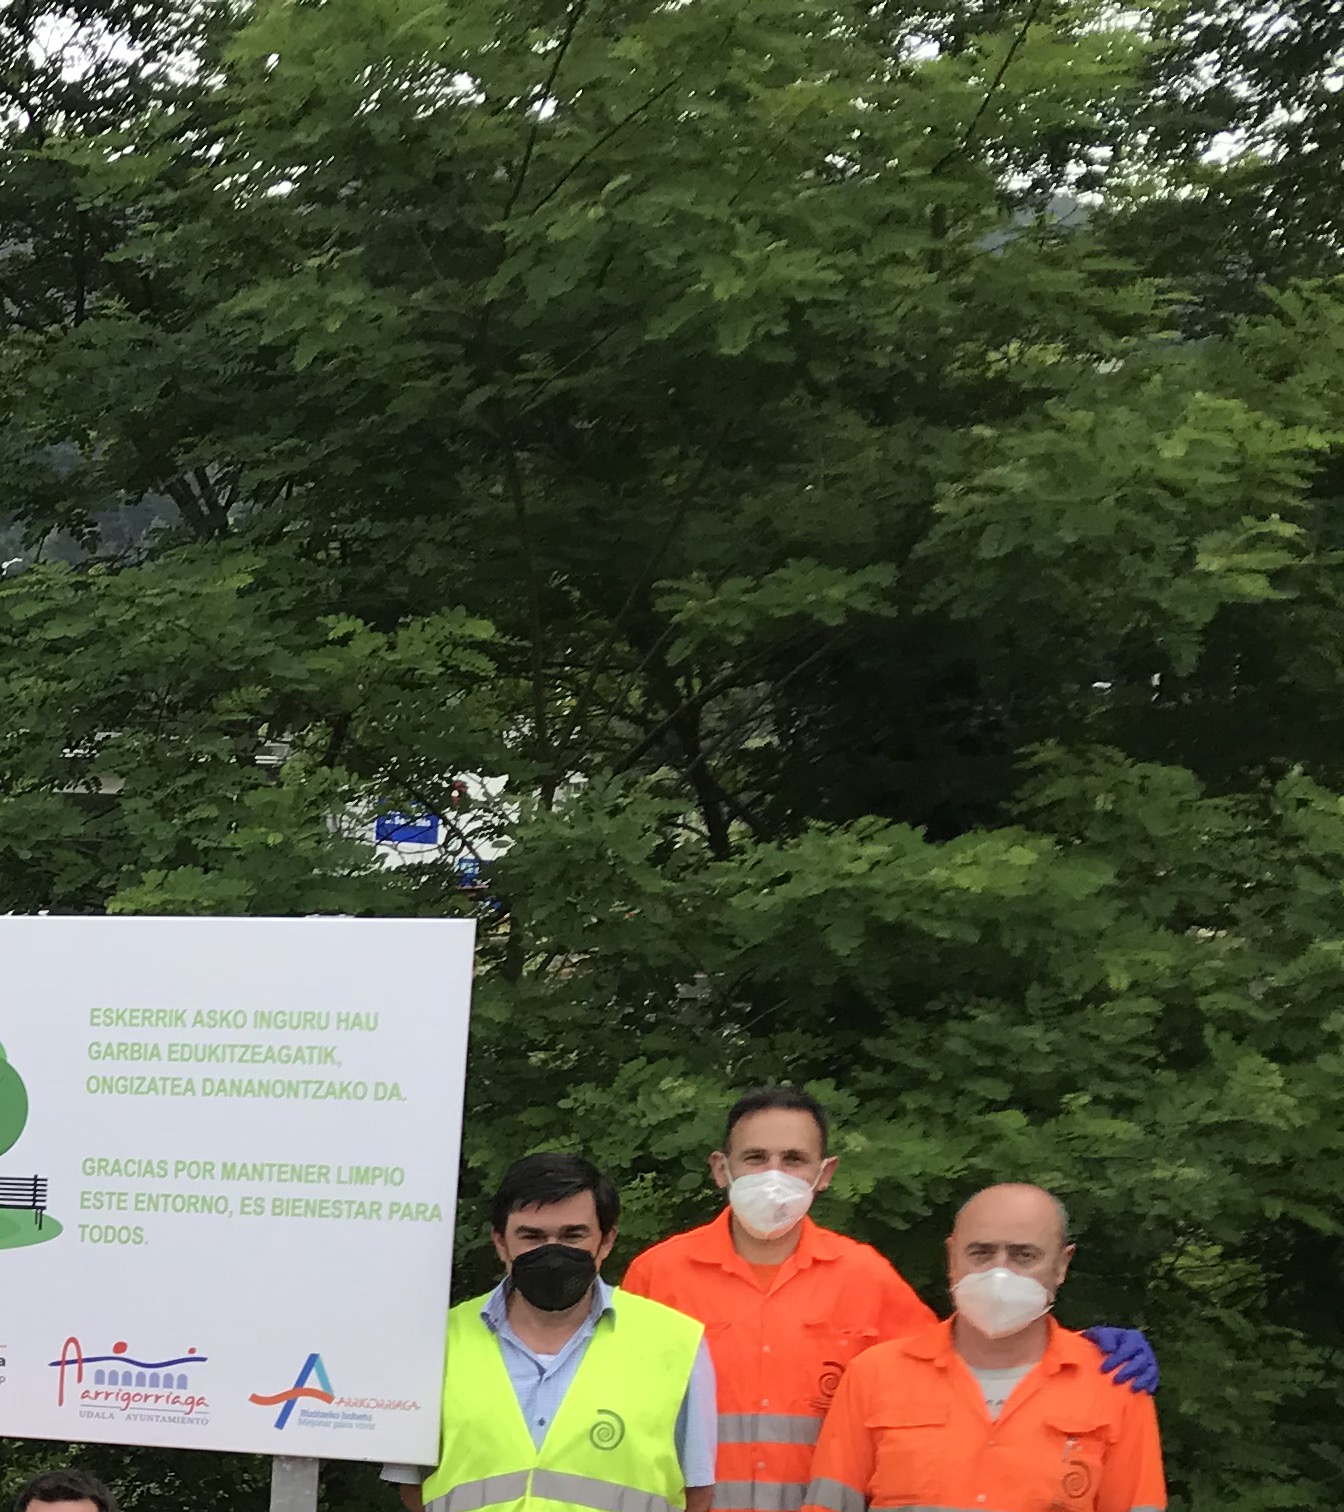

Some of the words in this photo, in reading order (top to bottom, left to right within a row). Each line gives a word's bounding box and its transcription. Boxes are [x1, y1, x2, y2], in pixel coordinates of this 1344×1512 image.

[89, 1007, 187, 1028] ESKERRIK
[191, 1009, 247, 1029] ASKO
[253, 1010, 330, 1031] INGURU
[335, 1011, 379, 1032] HAU
[87, 1041, 162, 1062] GARBIA
[167, 1042, 342, 1068] EDUKITZEAGATIK,
[86, 1075, 196, 1096] ONGIZATEA
[201, 1078, 368, 1100] DANANONTZAKO
[373, 1081, 407, 1102] DA.
[81, 1157, 168, 1179] GRACIAS
[173, 1160, 216, 1180] POR
[220, 1162, 331, 1184] MANTENER
[336, 1165, 405, 1187] LIMPIO
[79, 1191, 128, 1211] ESTE
[134, 1192, 233, 1219] ENTORNO,
[239, 1196, 265, 1216] ES
[270, 1198, 382, 1221] BIENESTAR
[387, 1202, 443, 1222] PARA
[78, 1224, 149, 1246] TODOS.
[79, 1410, 115, 1420] UDALA
[125, 1413, 210, 1426] AYUNTAMIENTO
